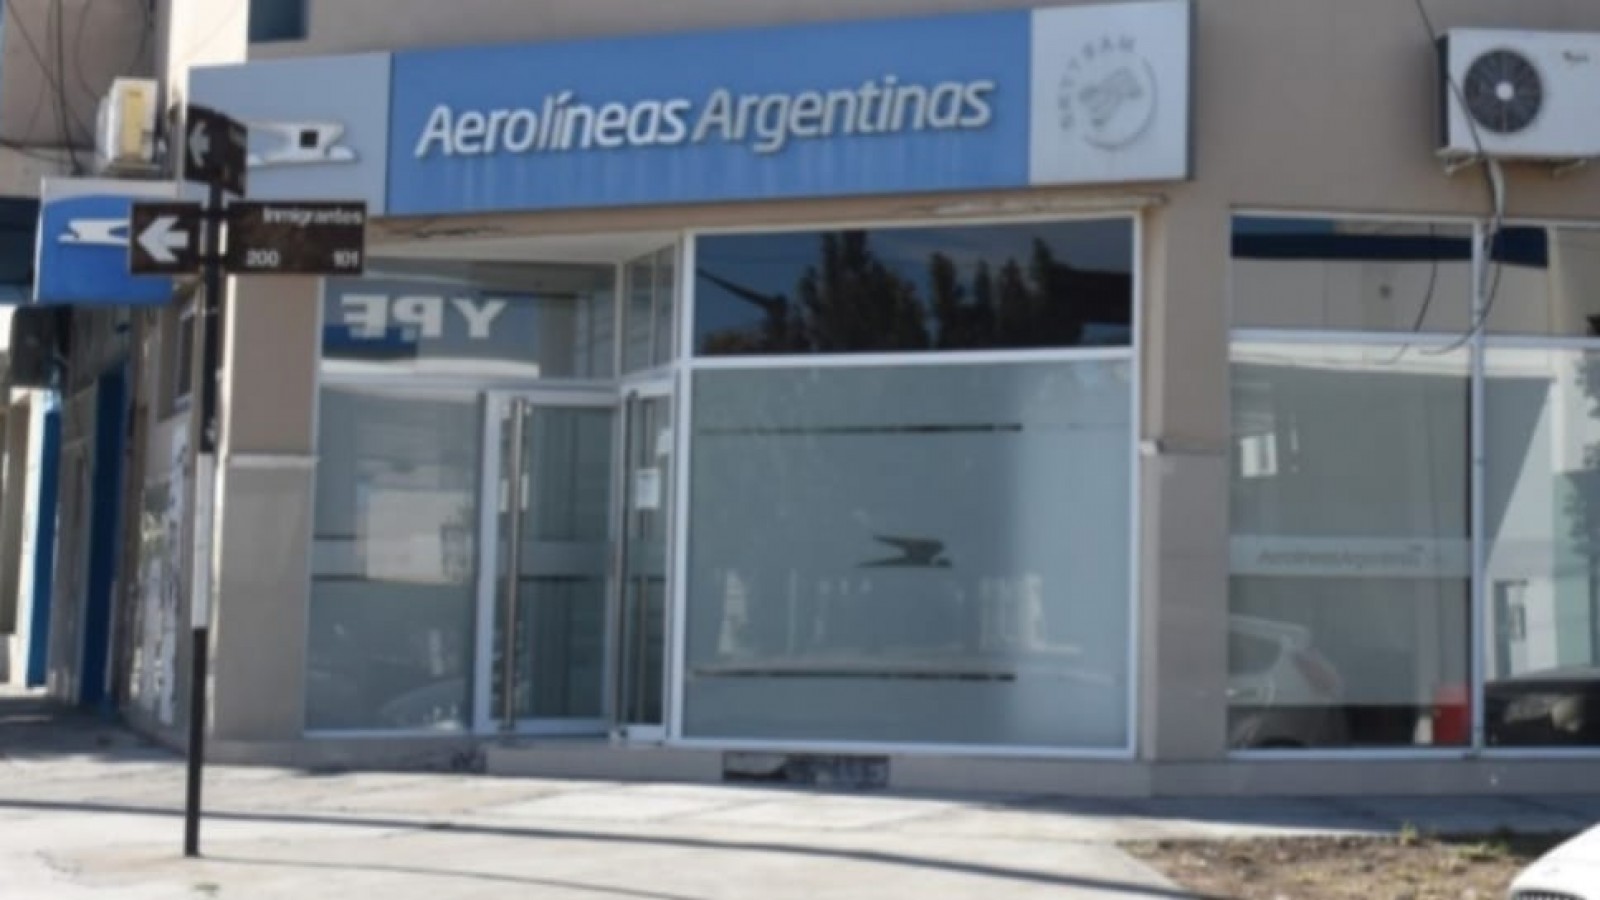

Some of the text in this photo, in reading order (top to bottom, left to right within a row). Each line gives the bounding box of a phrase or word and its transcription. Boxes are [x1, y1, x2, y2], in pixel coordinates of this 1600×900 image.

[414, 74, 994, 157] Aerolíneas Argentinas
[262, 206, 363, 228] Inmigrantes
[246, 250, 359, 267] 200 101
